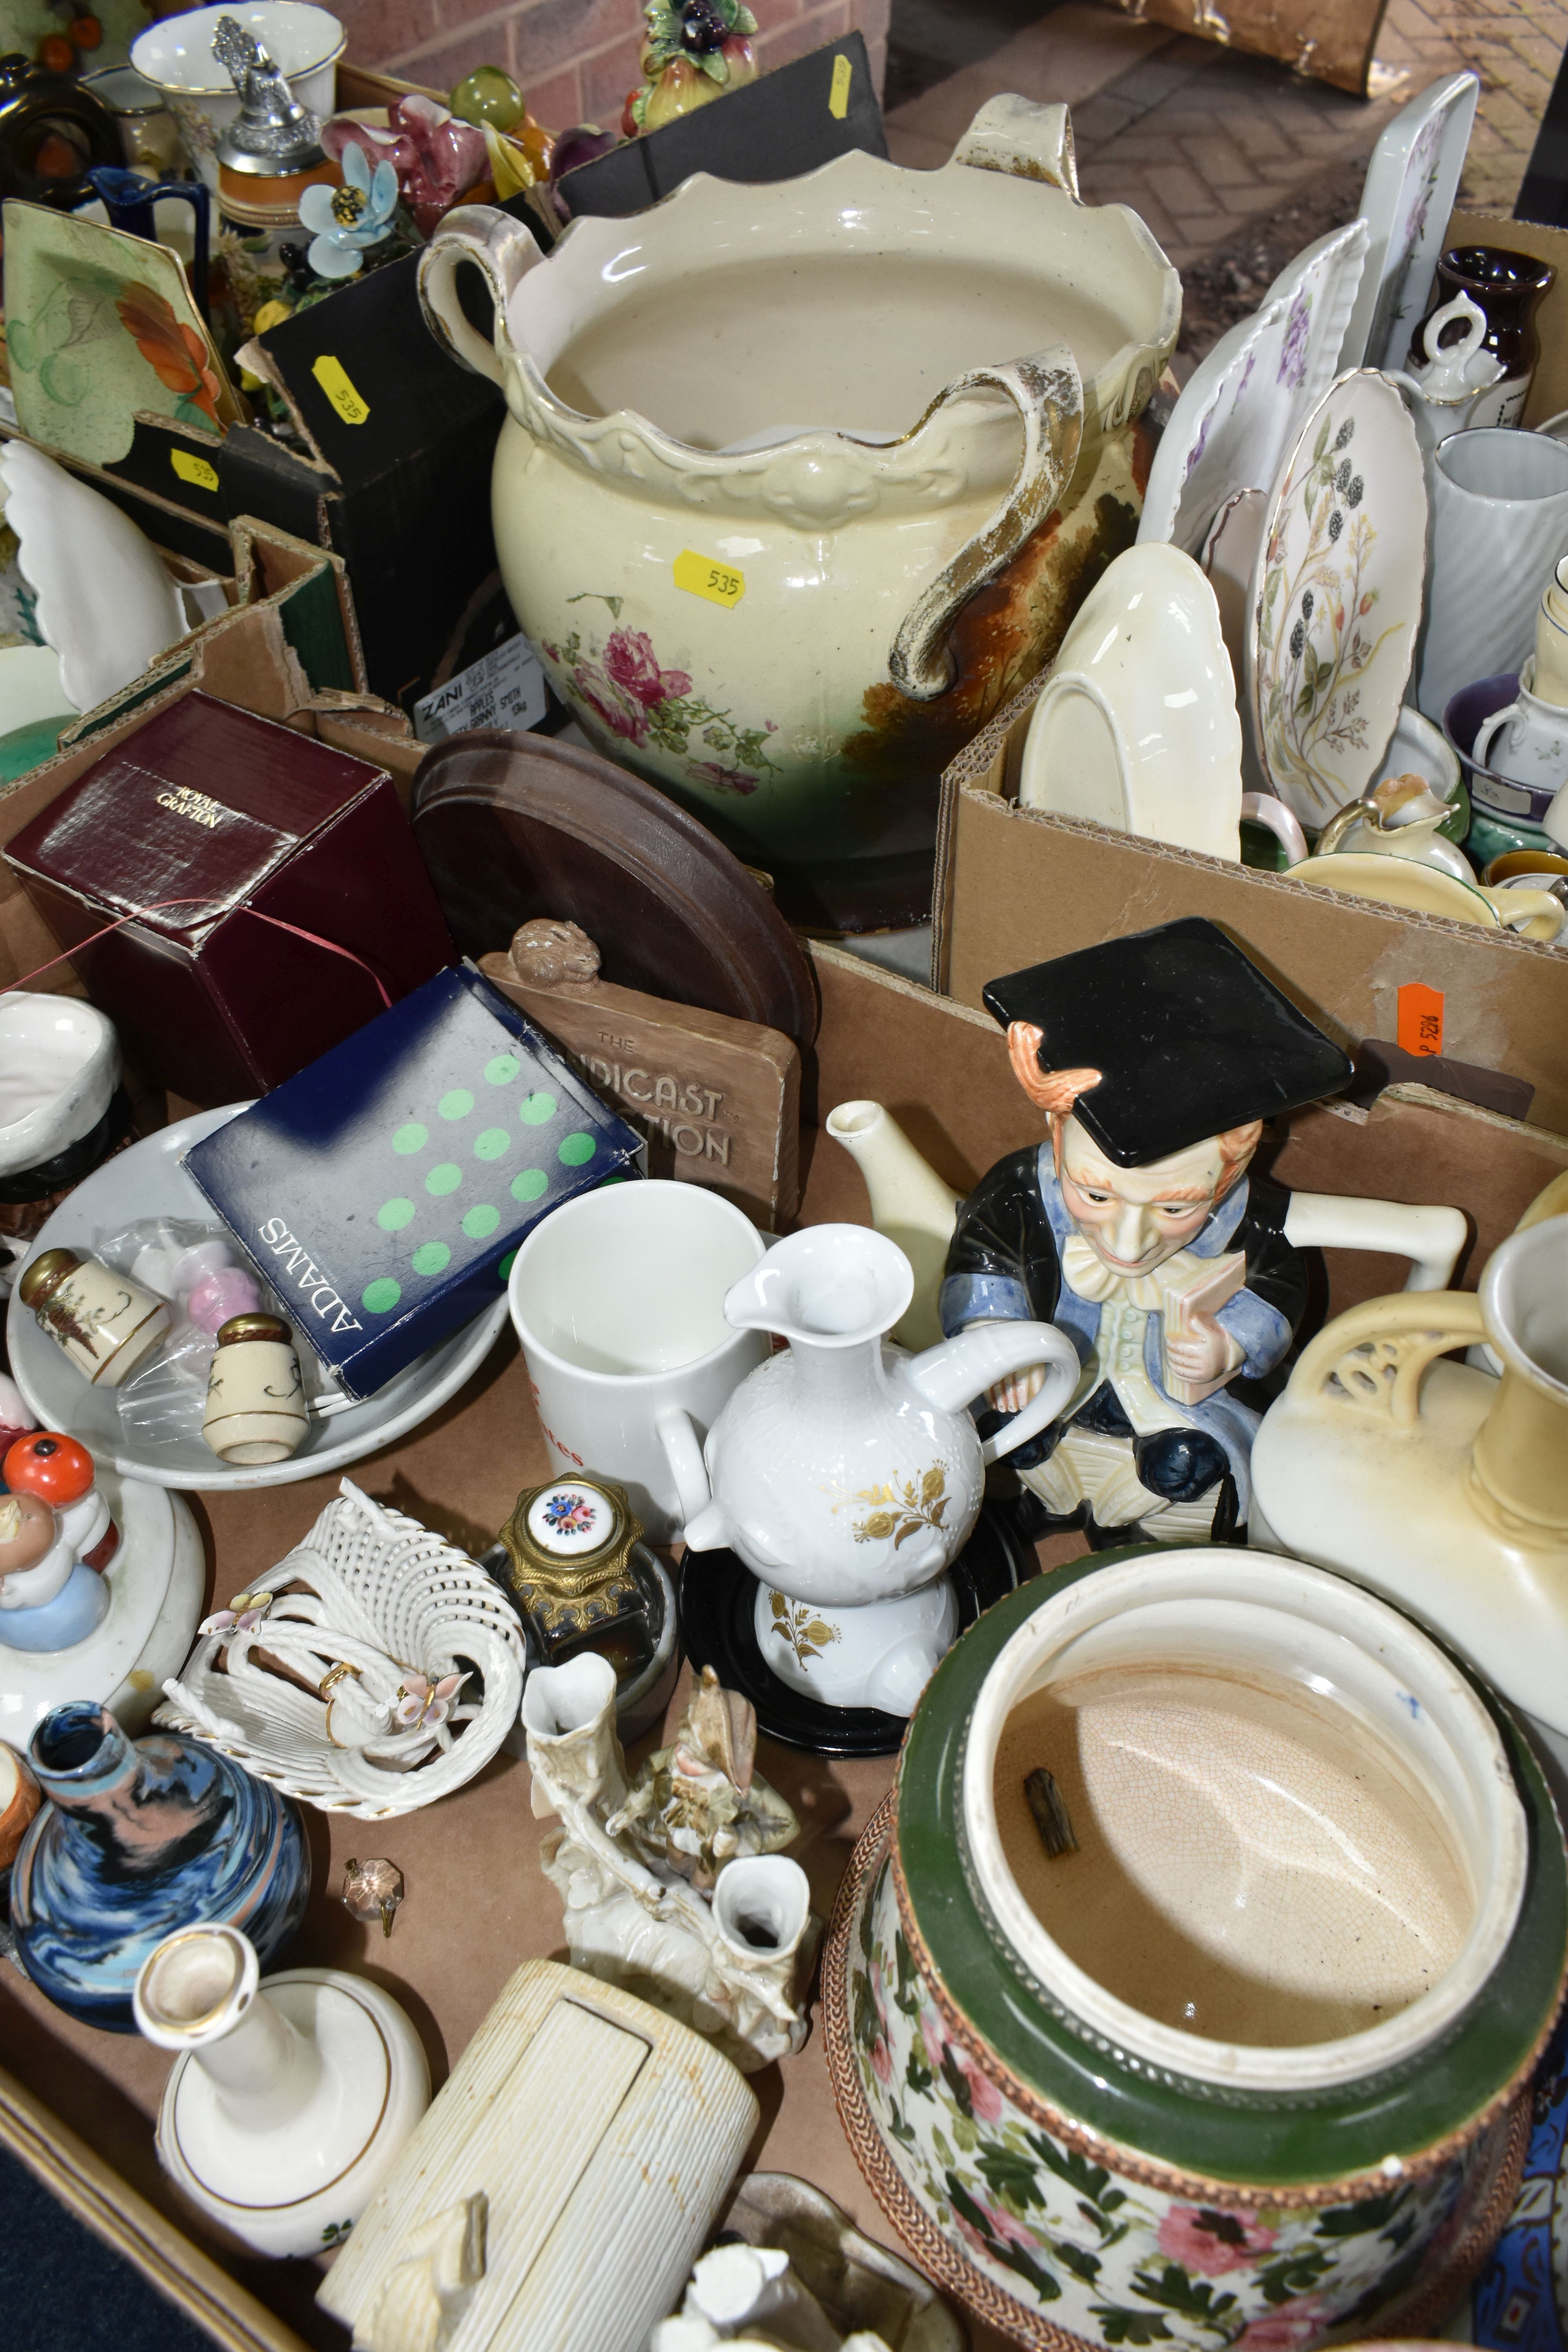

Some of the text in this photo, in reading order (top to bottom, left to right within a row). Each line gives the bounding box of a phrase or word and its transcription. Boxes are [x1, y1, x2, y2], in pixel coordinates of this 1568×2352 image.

[335, 389, 362, 418] 535
[707, 570, 740, 595] 535
[422, 683, 463, 722] ZANI
[157, 793, 223, 828] GRAFTON
[176, 786, 220, 813] ROYAL
[598, 1032, 635, 1054] THE
[567, 1051, 722, 1122] NDICAST
[617, 1108, 731, 1167] TION
[258, 1217, 363, 1333] ADAMS
